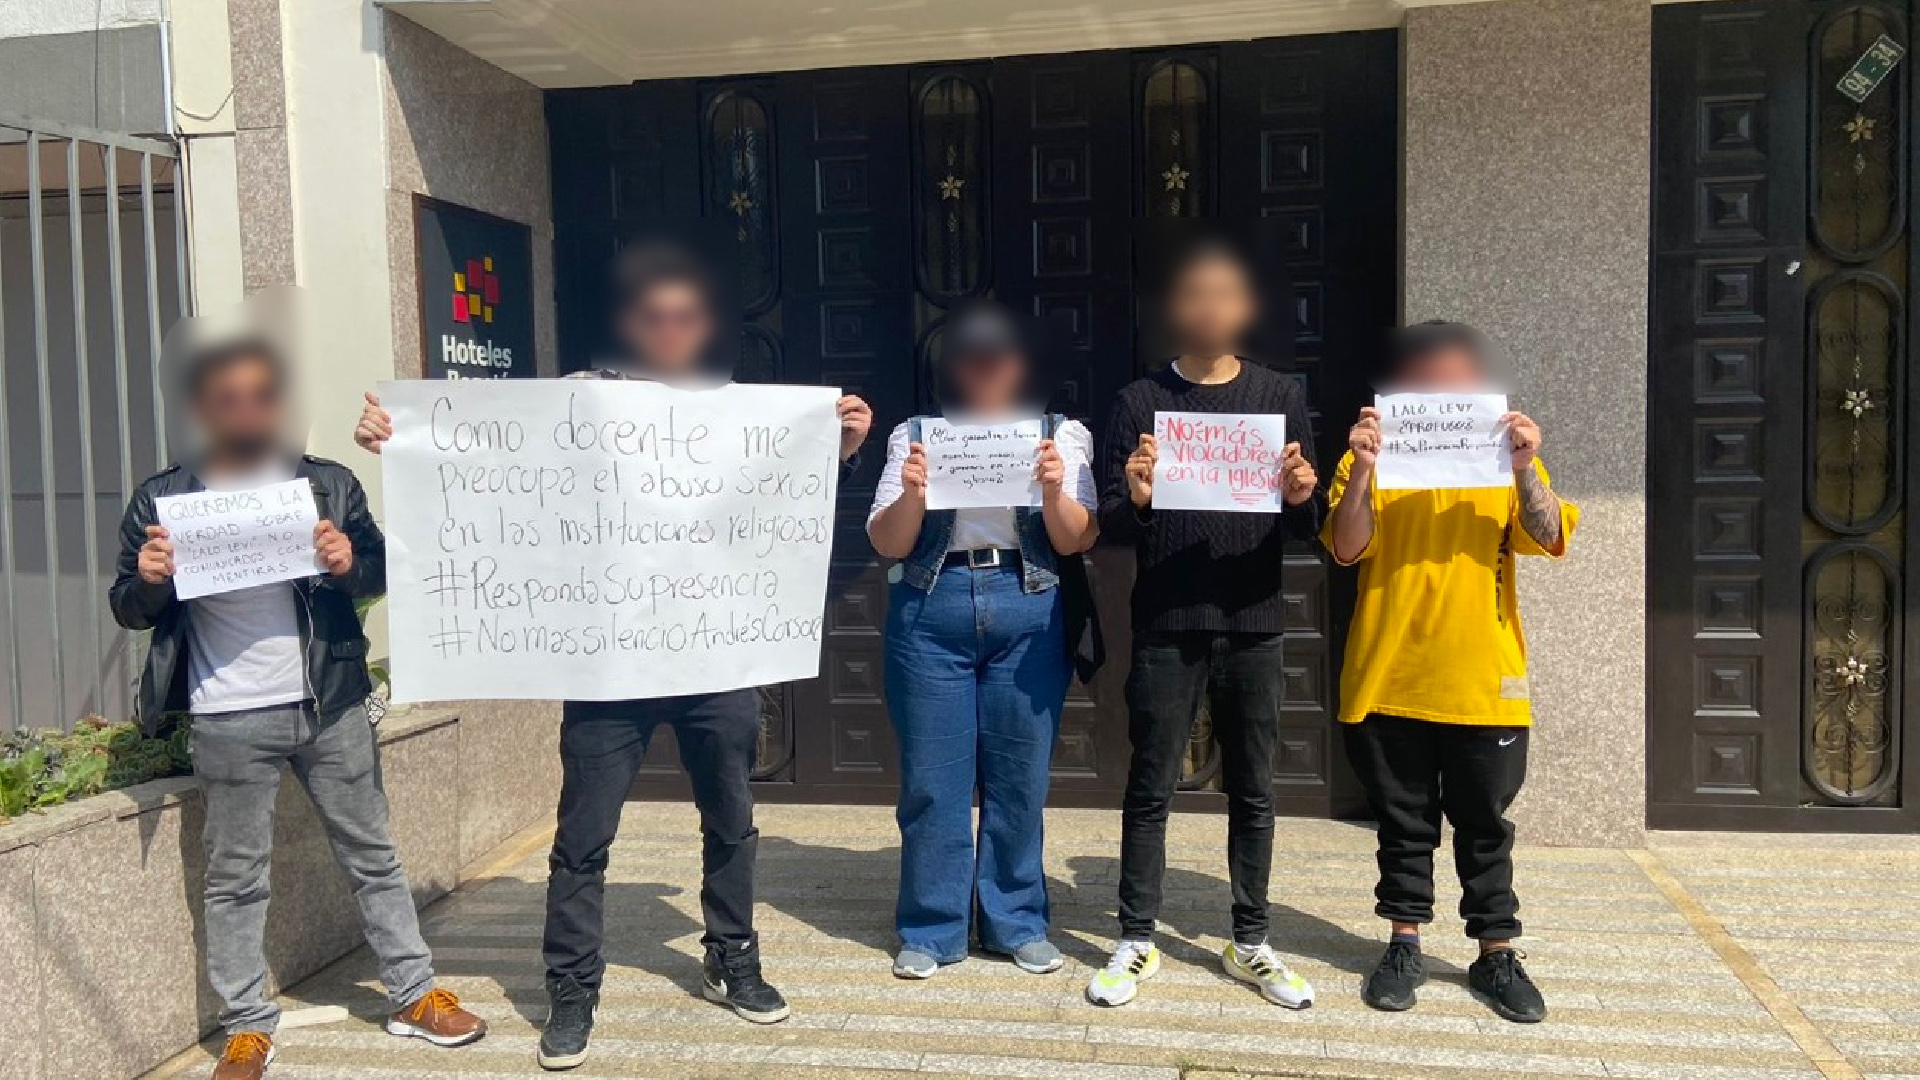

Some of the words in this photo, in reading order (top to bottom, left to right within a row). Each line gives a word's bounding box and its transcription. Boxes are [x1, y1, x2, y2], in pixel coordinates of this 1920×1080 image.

[442, 334, 512, 368] Hoteles
[1391, 403, 1427, 418] LALO
[432, 396, 524, 453] Como
[554, 392, 710, 464] docente
[742, 422, 790, 459] me
[1167, 417, 1195, 441] No
[1204, 420, 1264, 447] más
[438, 462, 576, 517] preocupa
[594, 460, 619, 494] el
[1166, 466, 1195, 482] en
[1201, 465, 1219, 485] la
[168, 491, 263, 521] QUEREMOS
[279, 488, 303, 506] LA
[173, 523, 240, 545] VERDAD
[255, 510, 304, 527] SOBRE
[268, 531, 293, 542] NO
[438, 518, 483, 552] en
[498, 506, 541, 546] las
[555, 501, 716, 546] instituciones
[729, 506, 828, 558] religiosas
[277, 542, 306, 556] CON
[213, 563, 289, 584] MENTIRAS
